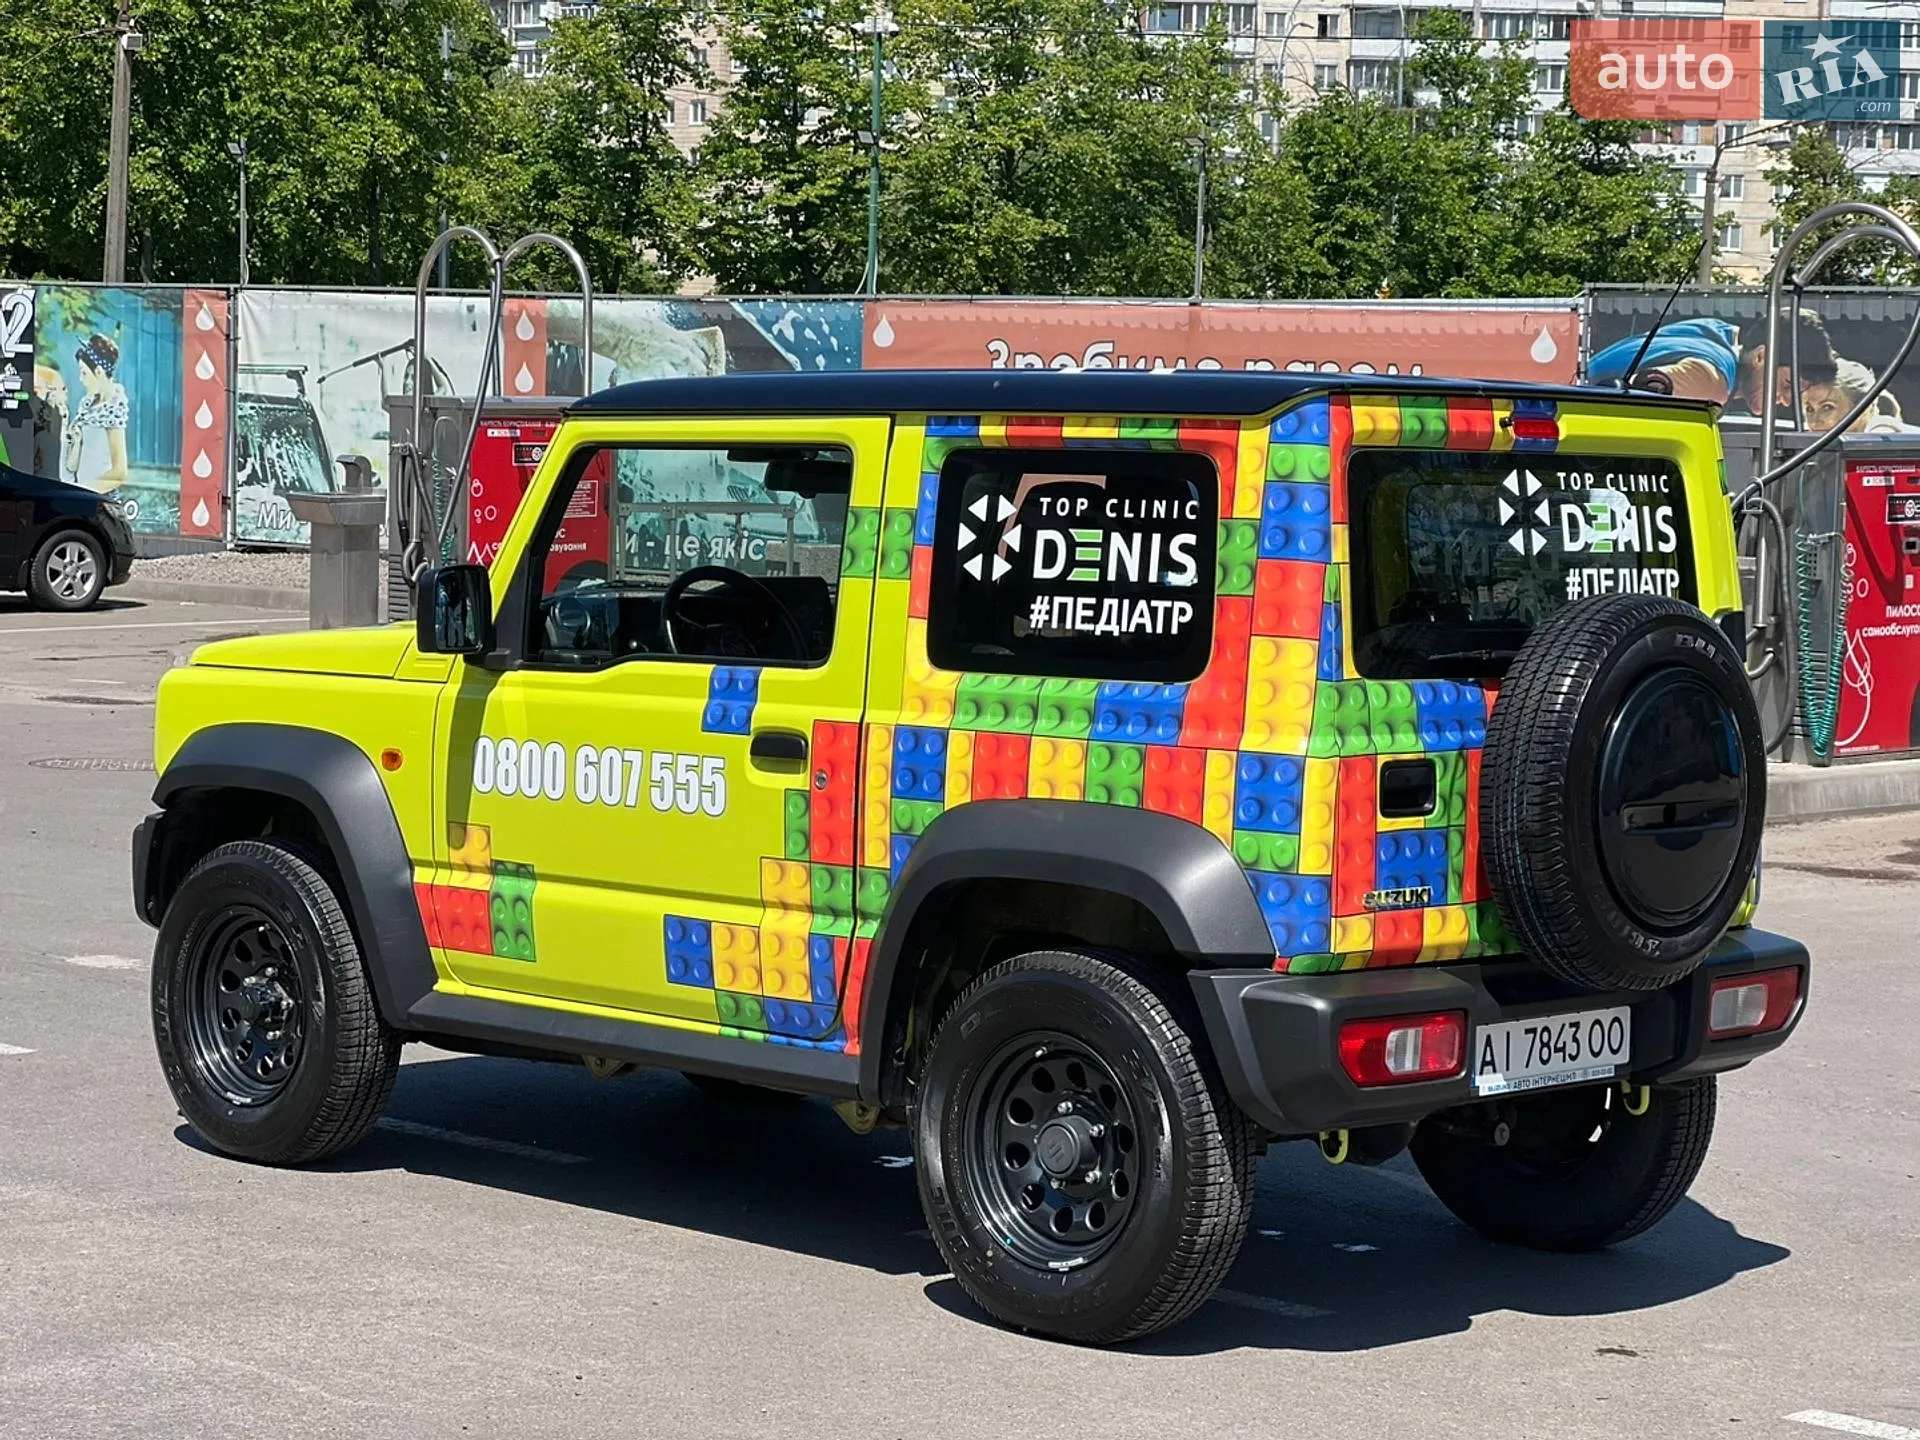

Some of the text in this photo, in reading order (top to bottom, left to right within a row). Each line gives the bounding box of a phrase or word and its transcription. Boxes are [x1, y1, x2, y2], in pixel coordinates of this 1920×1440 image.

[1557, 472, 1670, 493] TOP CLINIC
[1039, 497, 1199, 520] TOP CLINIC
[1561, 502, 1678, 553] DENIS
[1033, 529, 1199, 587] DENIS
[1030, 595, 1194, 636] #ПЕДІАТР
[473, 735, 727, 817] 0800 607 555
[1363, 887, 1432, 906] SUZUKI
[1524, 1021, 1581, 1068] 7843
